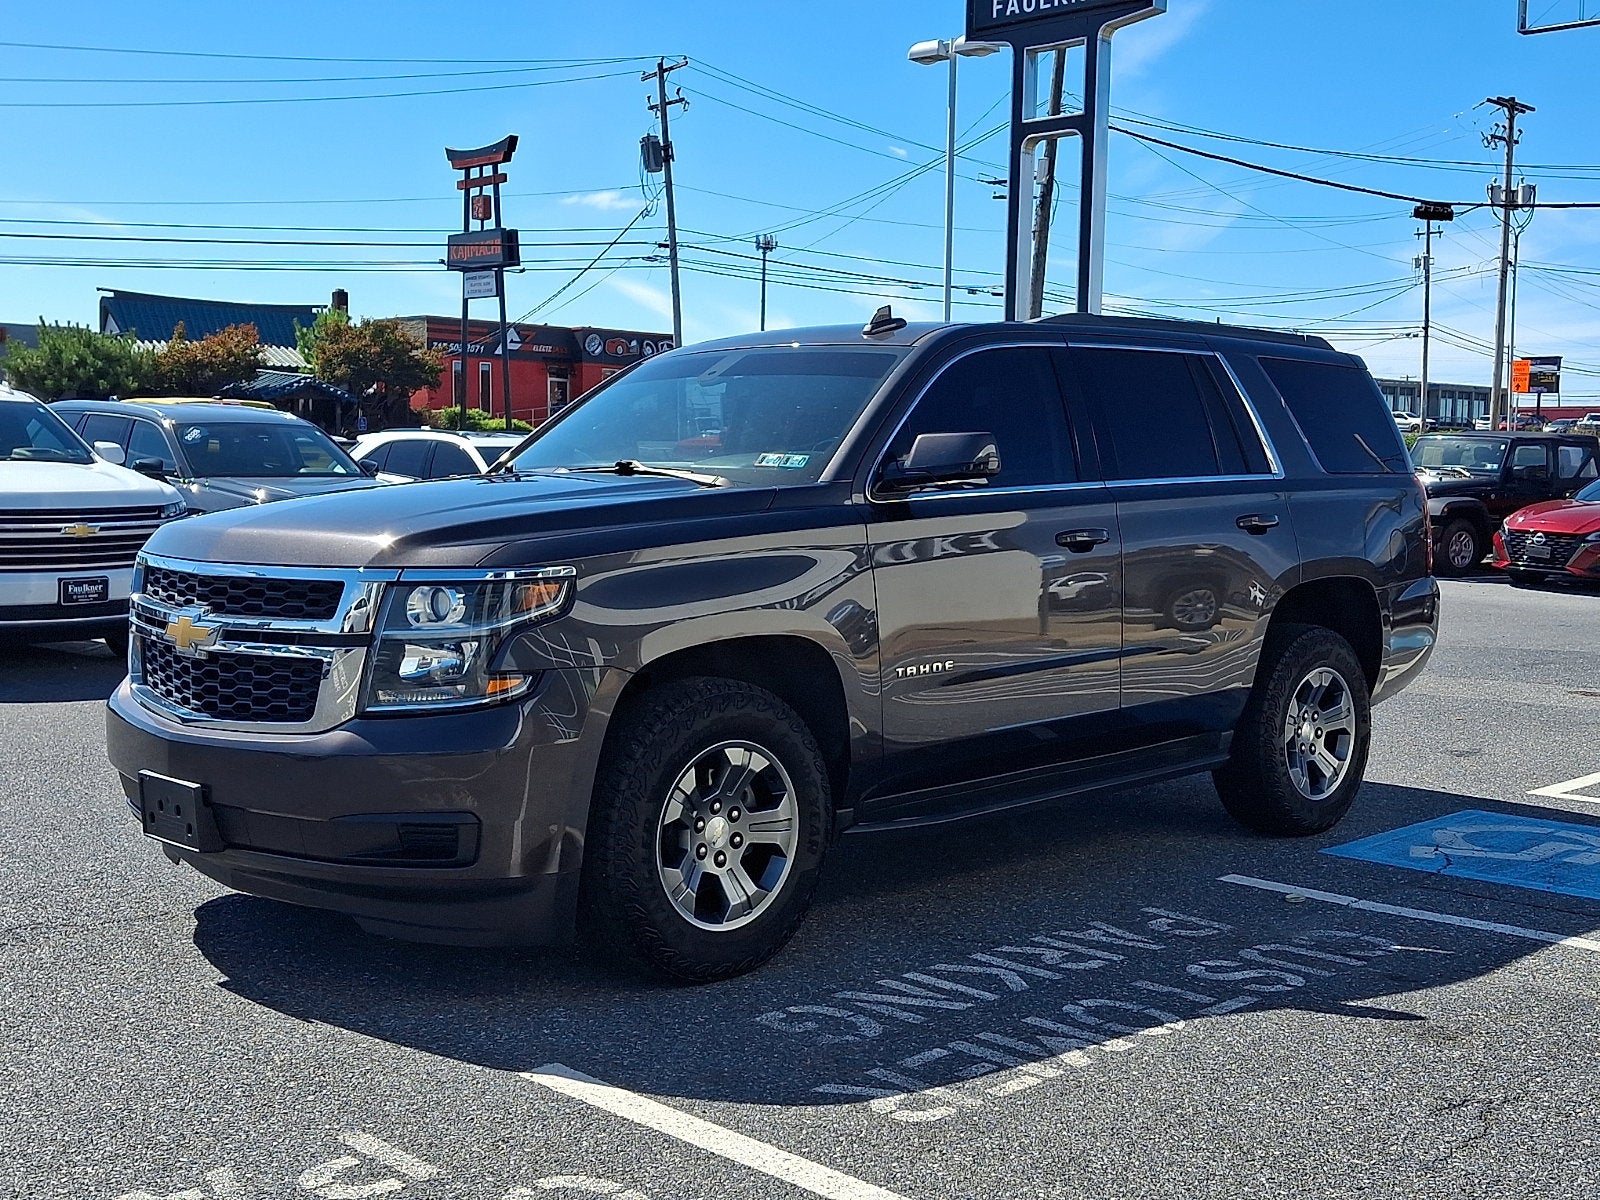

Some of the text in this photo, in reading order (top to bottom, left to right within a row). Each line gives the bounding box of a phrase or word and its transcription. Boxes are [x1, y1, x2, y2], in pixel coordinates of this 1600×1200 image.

[992, 0, 1086, 18] FAU
[450, 239, 501, 261] KAJIMACHI
[68, 584, 103, 593] Faulkner
[895, 660, 954, 677] TAHOE
[754, 907, 1233, 1043] PARKING
[812, 930, 1396, 1123] CUSTOMER
